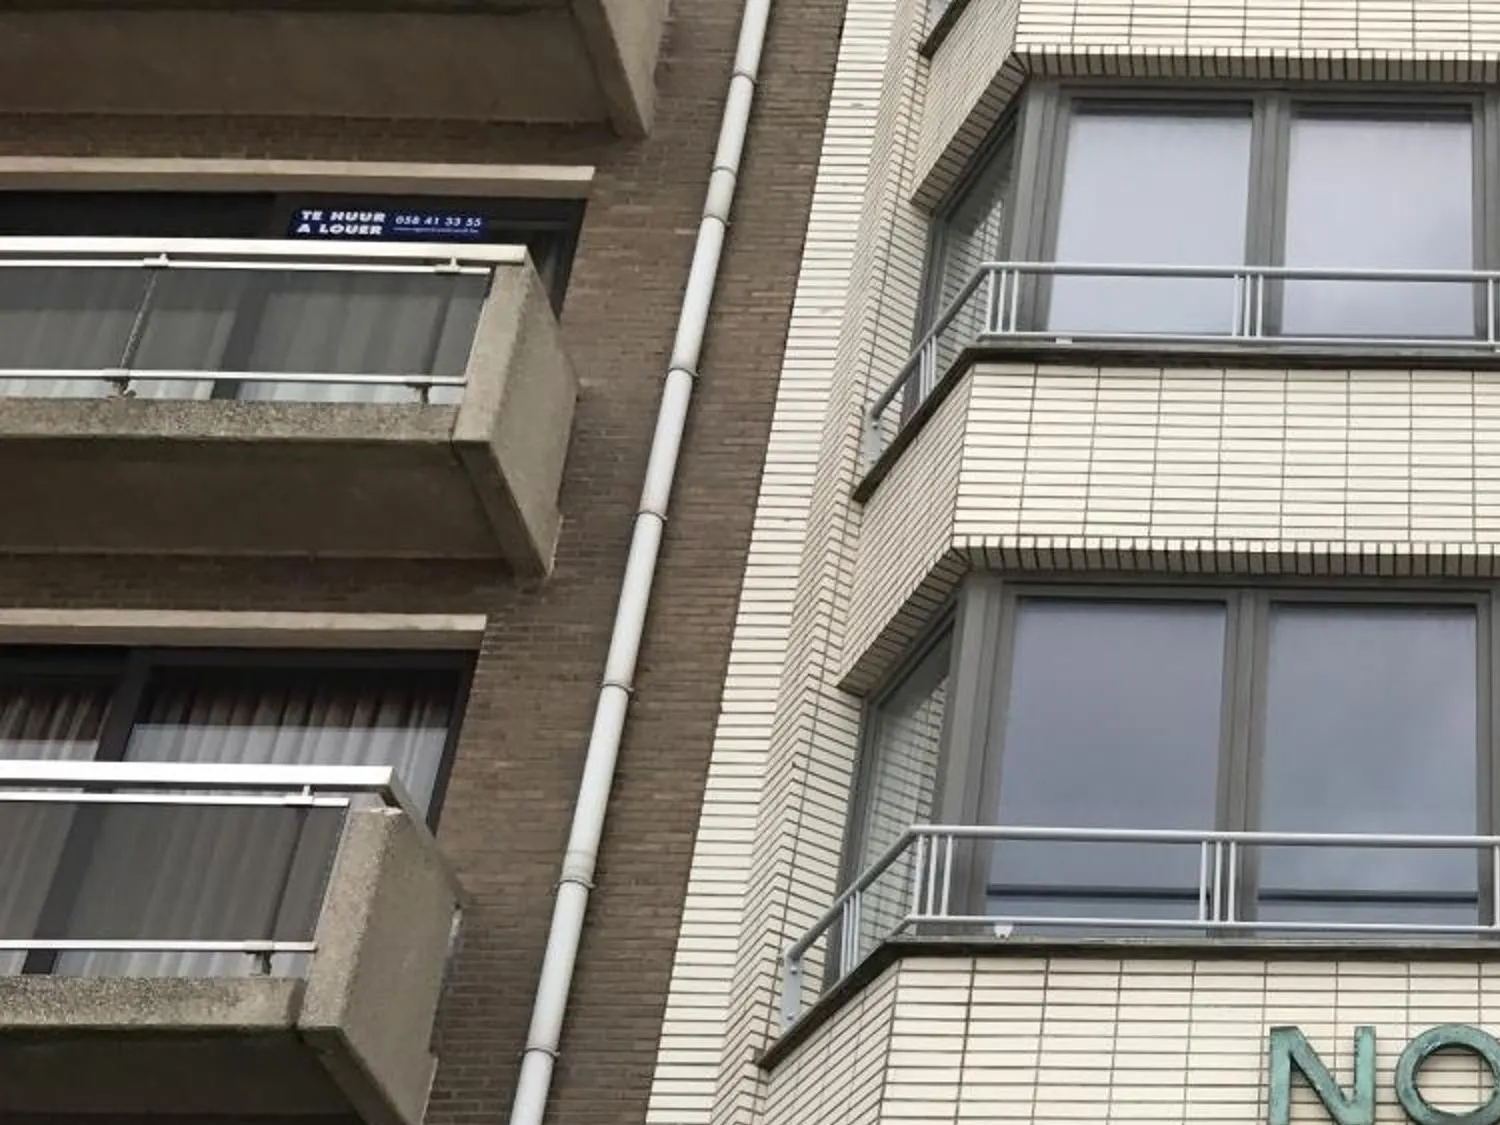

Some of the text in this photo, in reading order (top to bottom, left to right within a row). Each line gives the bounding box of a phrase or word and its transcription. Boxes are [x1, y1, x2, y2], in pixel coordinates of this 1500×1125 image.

[301, 210, 386, 223] TE HUUR
[395, 215, 420, 225] 058
[423, 216, 439, 226] 41
[465, 217, 482, 227] 55
[296, 223, 311, 233] A
[319, 223, 383, 235] LOUER
